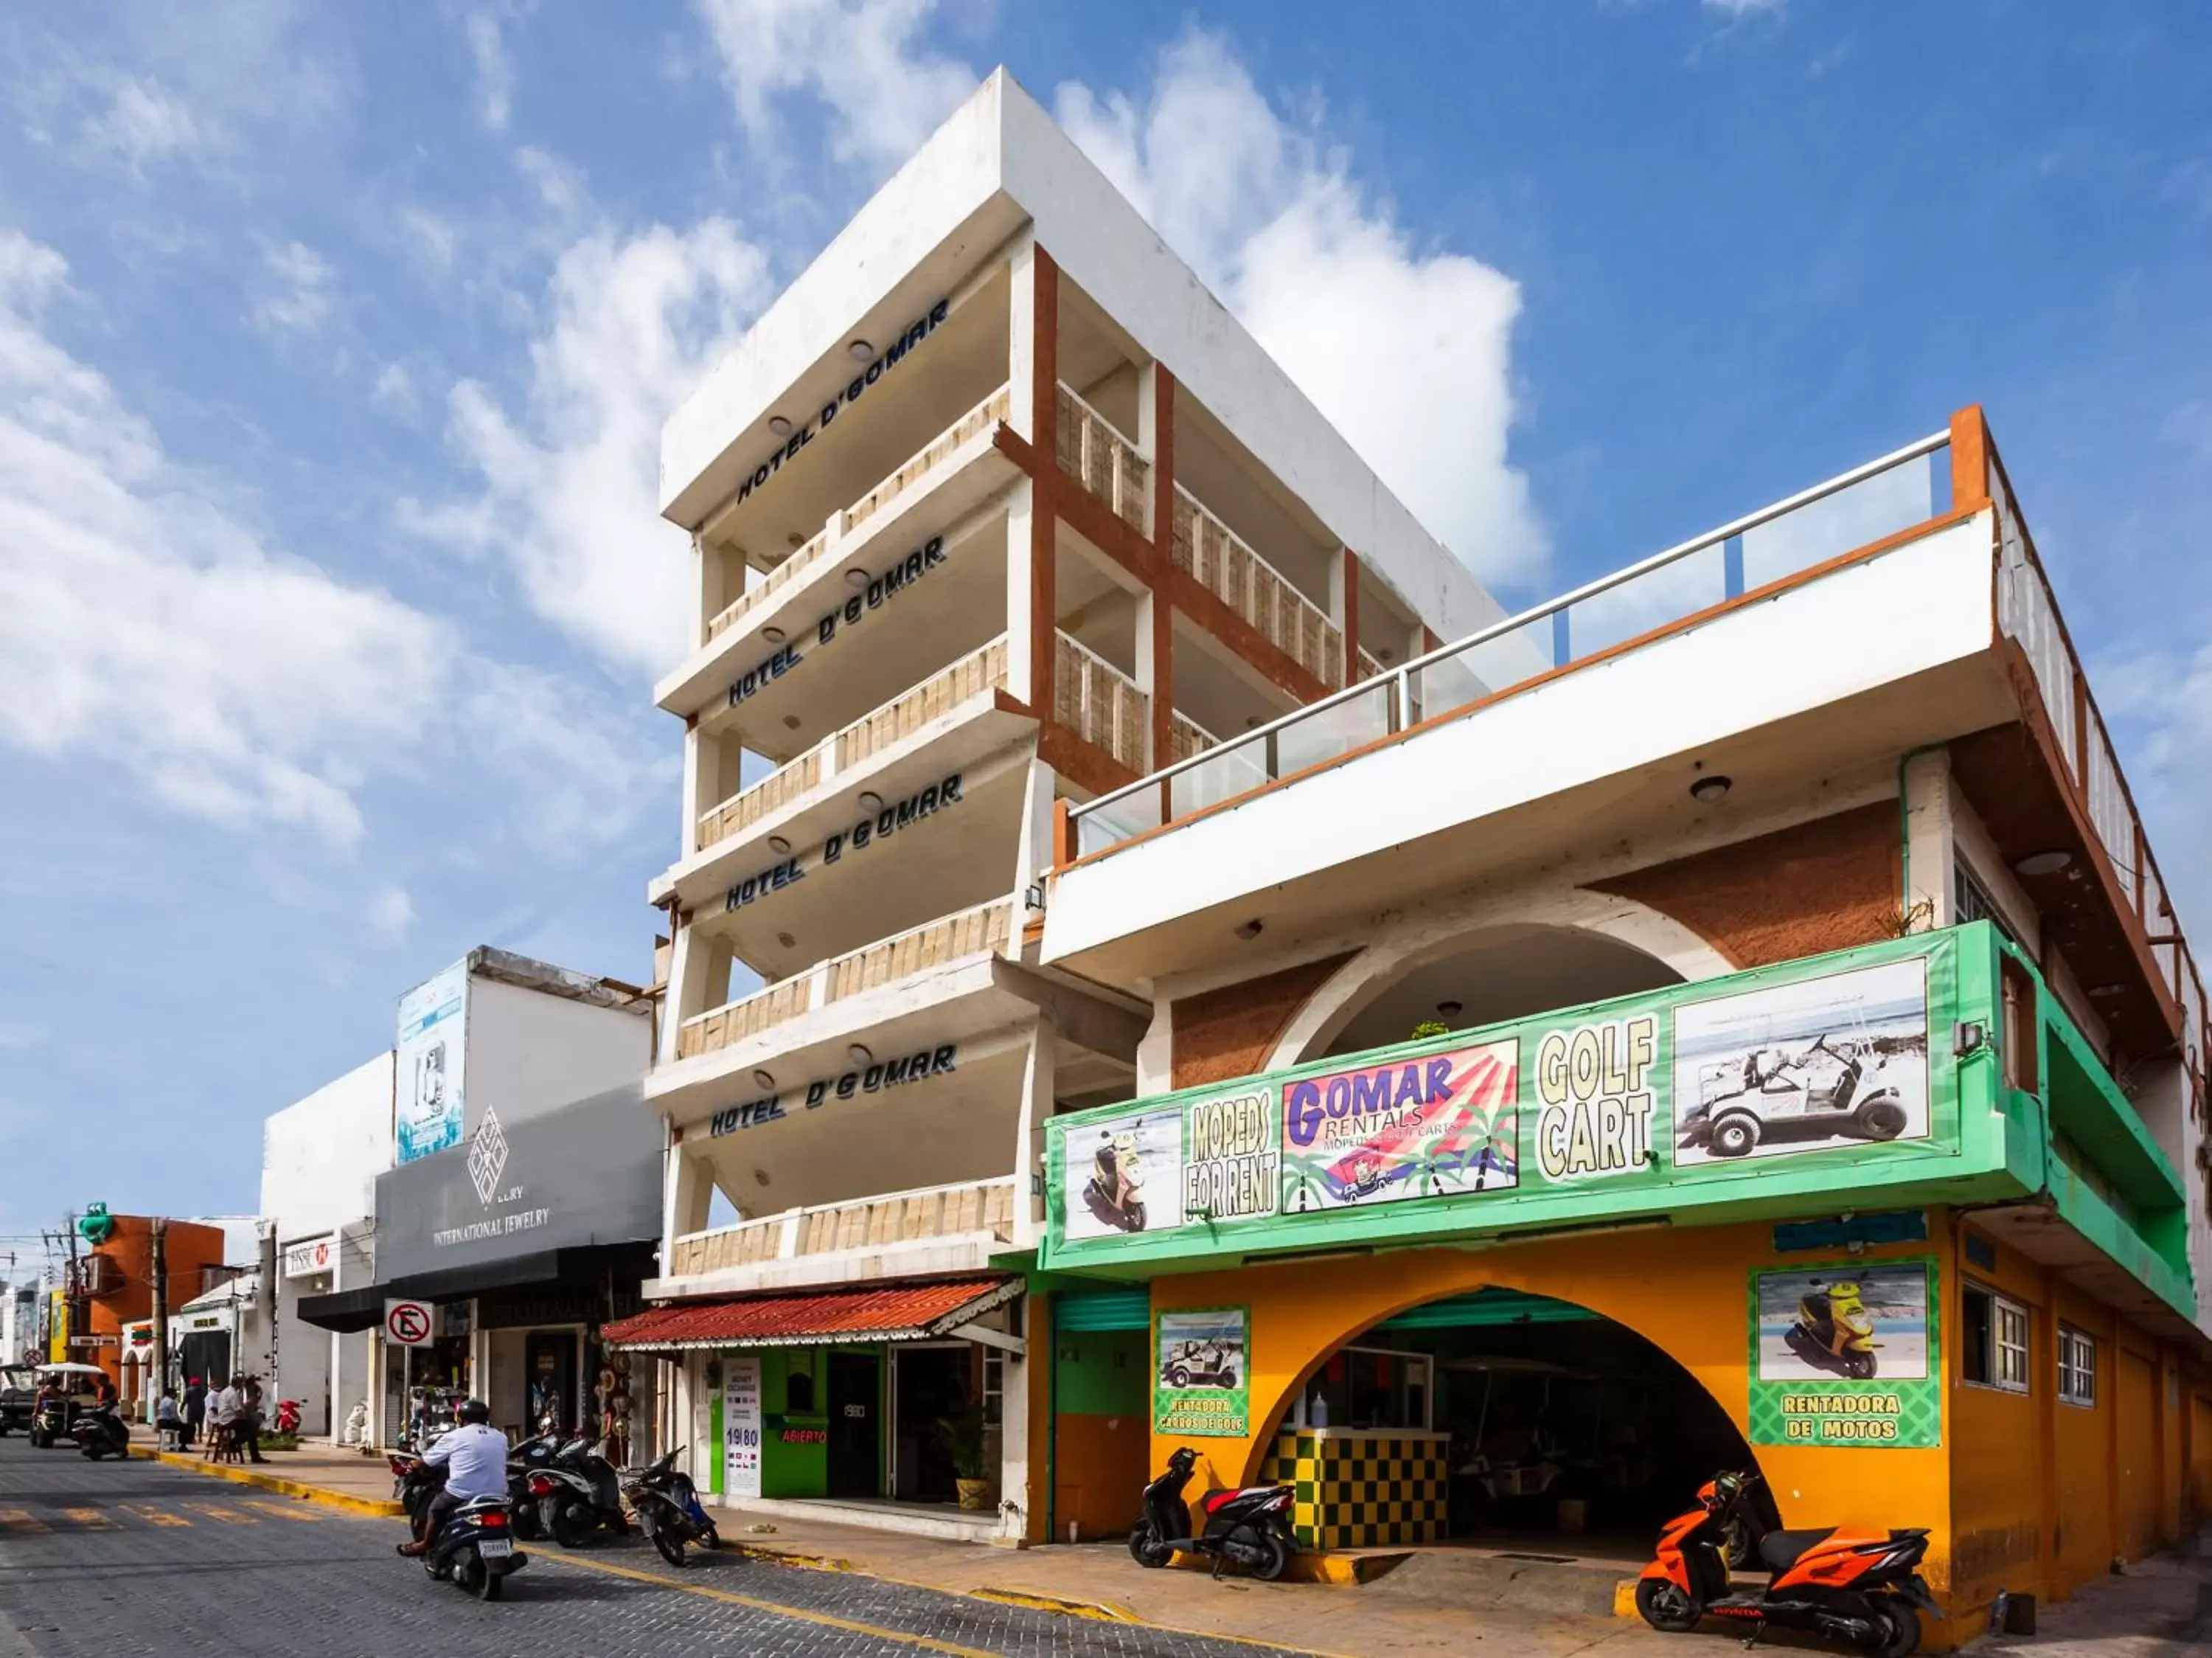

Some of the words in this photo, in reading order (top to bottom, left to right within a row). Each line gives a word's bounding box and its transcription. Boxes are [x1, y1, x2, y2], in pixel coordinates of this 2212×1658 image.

[737, 428, 815, 505] HOTEL
[821, 299, 949, 429] D'GOMAR
[729, 645, 804, 708] HOTEL
[726, 859, 806, 912] HOTEL
[1540, 1019, 1652, 1104] GOLF
[710, 1095, 786, 1138] HOTEL
[1290, 1058, 1453, 1146] GOMAR
[1324, 1106, 1424, 1140] RENTALS
[1193, 1092, 1269, 1163] MOPEDS
[1323, 1134, 1369, 1152] MOPEDS
[1540, 1093, 1651, 1177] CART
[1187, 1162, 1224, 1221] FOR
[1227, 1152, 1276, 1216] RENT
[434, 1218, 503, 1247] INTERNATIONAL
[504, 1207, 550, 1235] JEWELRY
[1200, 1418, 1215, 1429] DE
[1782, 1395, 1900, 1415] RENTADORA
[1787, 1419, 1812, 1438] DE
[1822, 1420, 1896, 1439] MOTOS
[781, 1429, 827, 1443] ABIERTO
